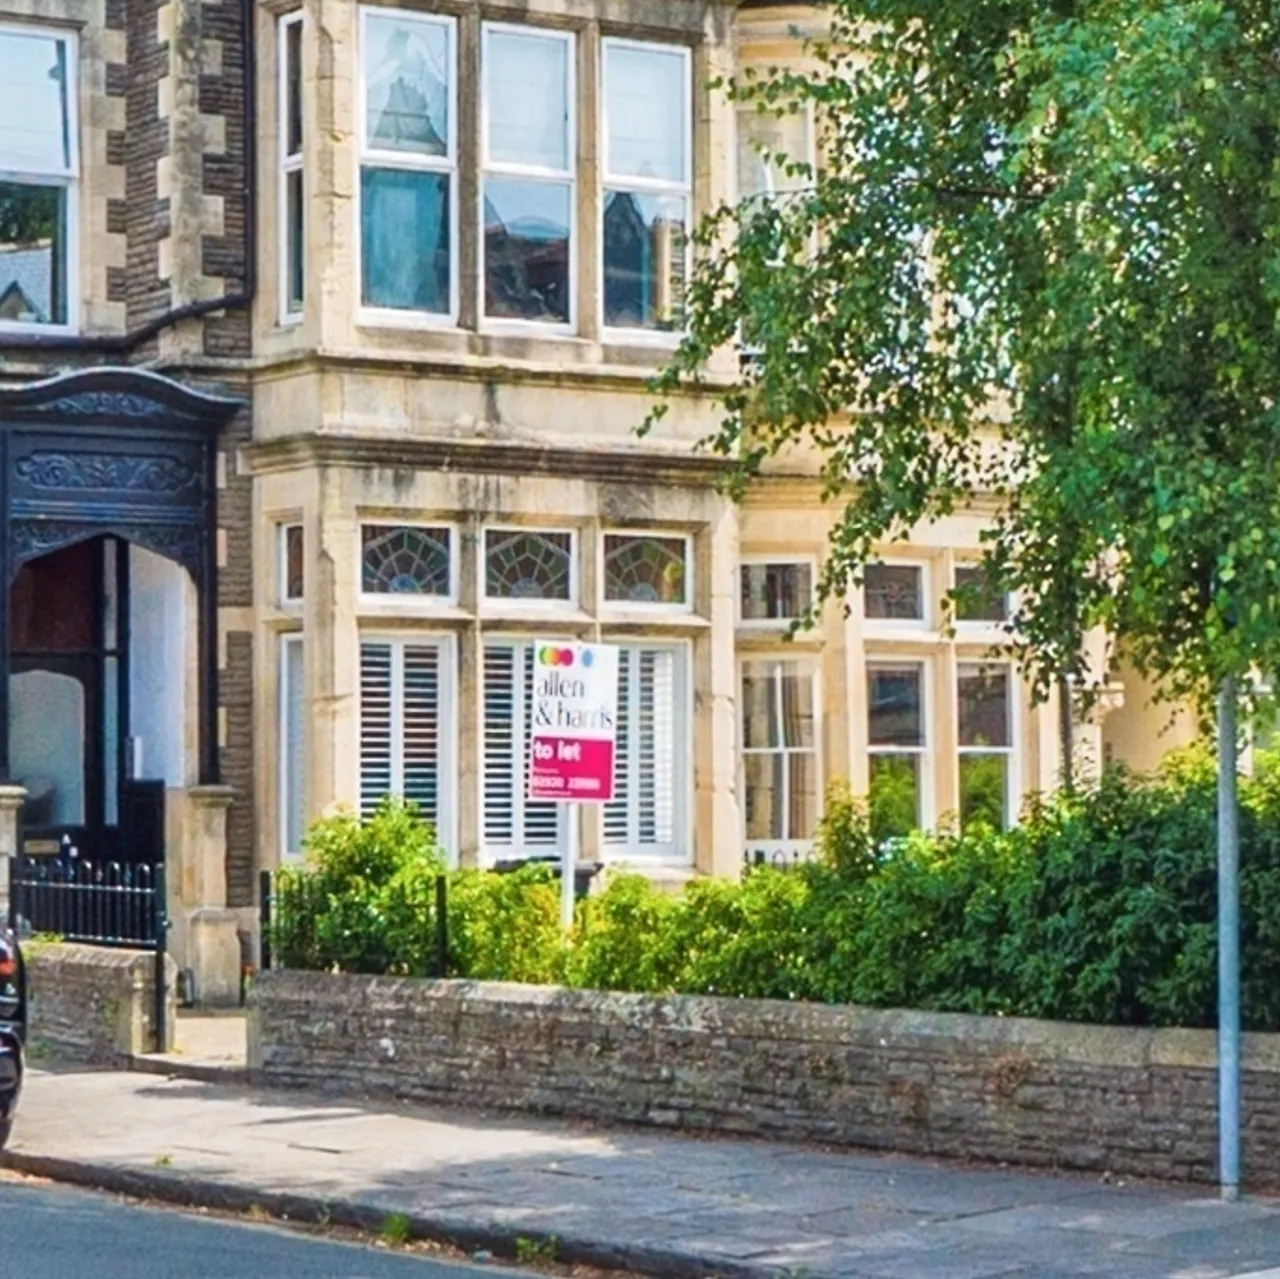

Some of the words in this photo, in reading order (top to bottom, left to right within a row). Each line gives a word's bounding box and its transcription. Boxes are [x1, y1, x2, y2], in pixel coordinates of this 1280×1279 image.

[536, 671, 585, 699] allen
[535, 700, 552, 727] &
[557, 701, 613, 730] harris
[534, 740, 554, 761] to
[557, 740, 582, 763] let
